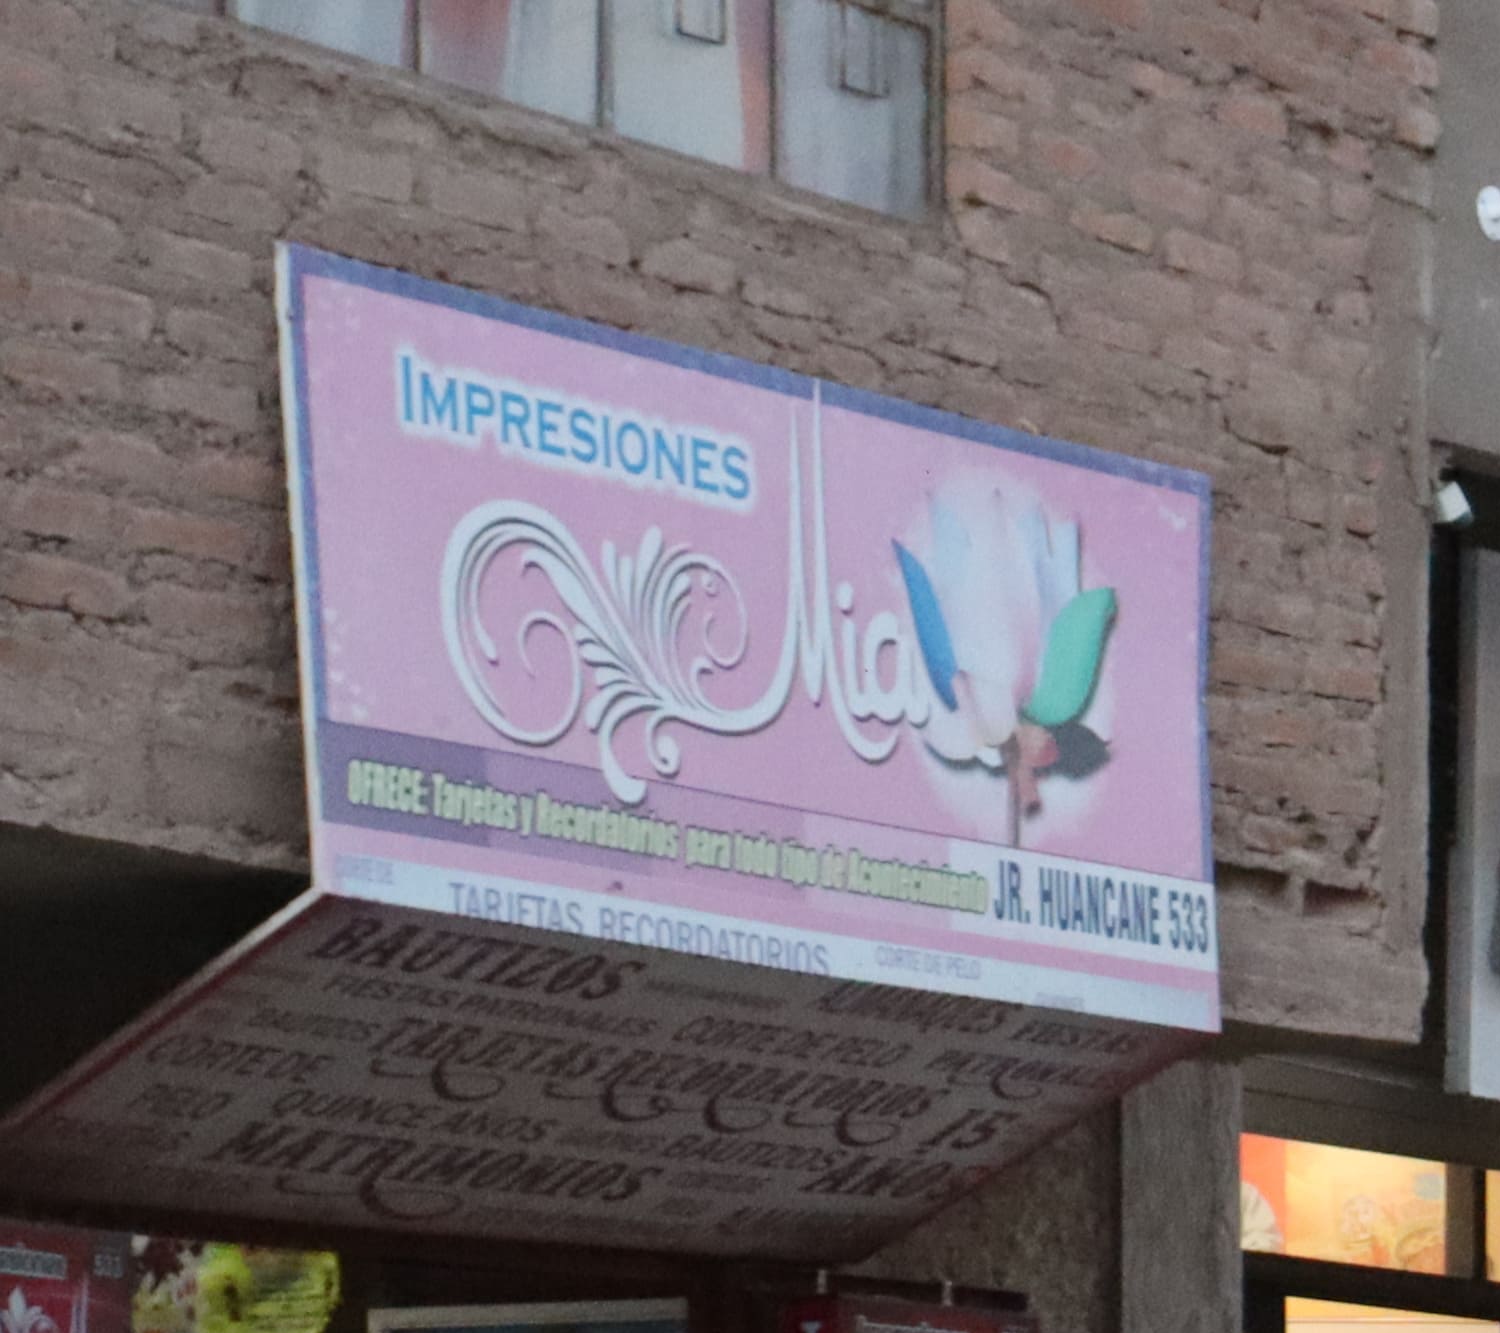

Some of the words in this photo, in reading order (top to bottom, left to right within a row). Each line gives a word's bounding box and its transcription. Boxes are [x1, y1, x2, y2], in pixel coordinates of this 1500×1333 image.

[397, 355, 751, 501] IMPRESIONES
[431, 773, 518, 829] Tarjetas
[536, 790, 679, 858] Recordatorios
[686, 824, 731, 870] para
[992, 858, 1032, 926] JR.
[1038, 868, 1158, 946] HUANCANE
[1165, 888, 1211, 957] 533
[310, 915, 645, 1002] BAUTIZOS
